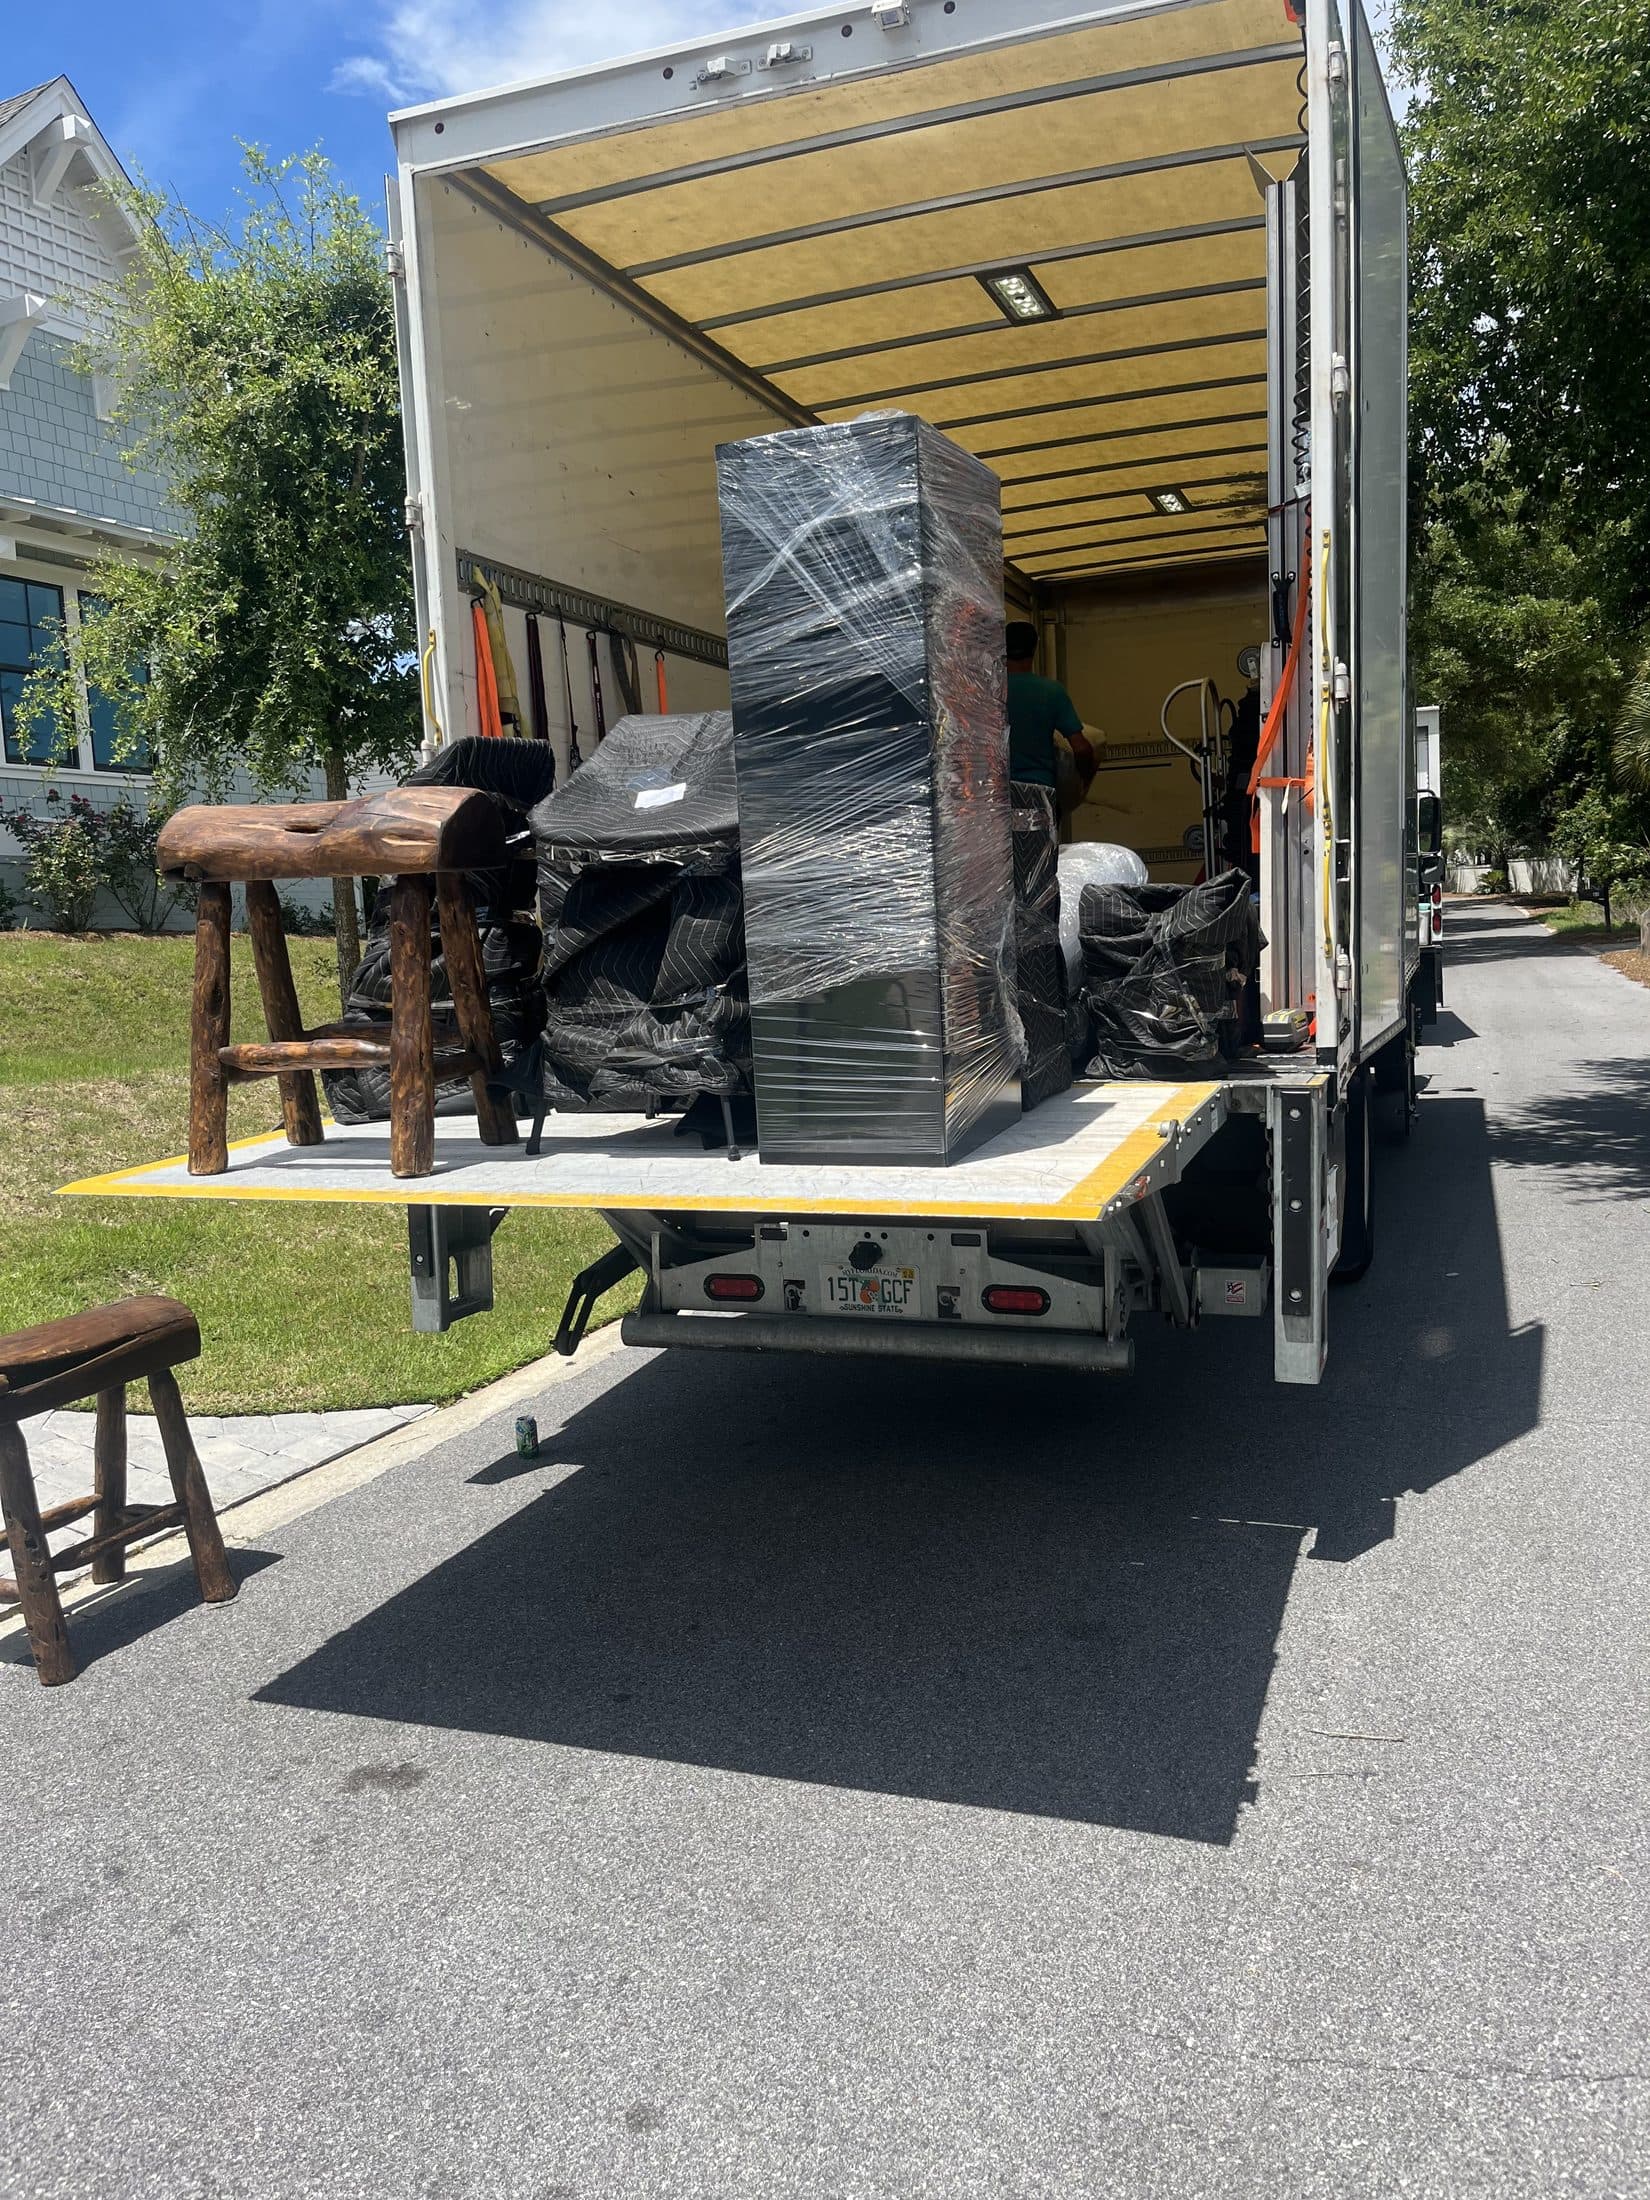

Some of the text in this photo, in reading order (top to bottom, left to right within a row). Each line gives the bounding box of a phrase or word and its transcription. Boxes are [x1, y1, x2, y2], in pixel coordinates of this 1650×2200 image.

[881, 1279, 914, 1304] GCF
[844, 1303, 899, 1313] SUNSHINE STATE
